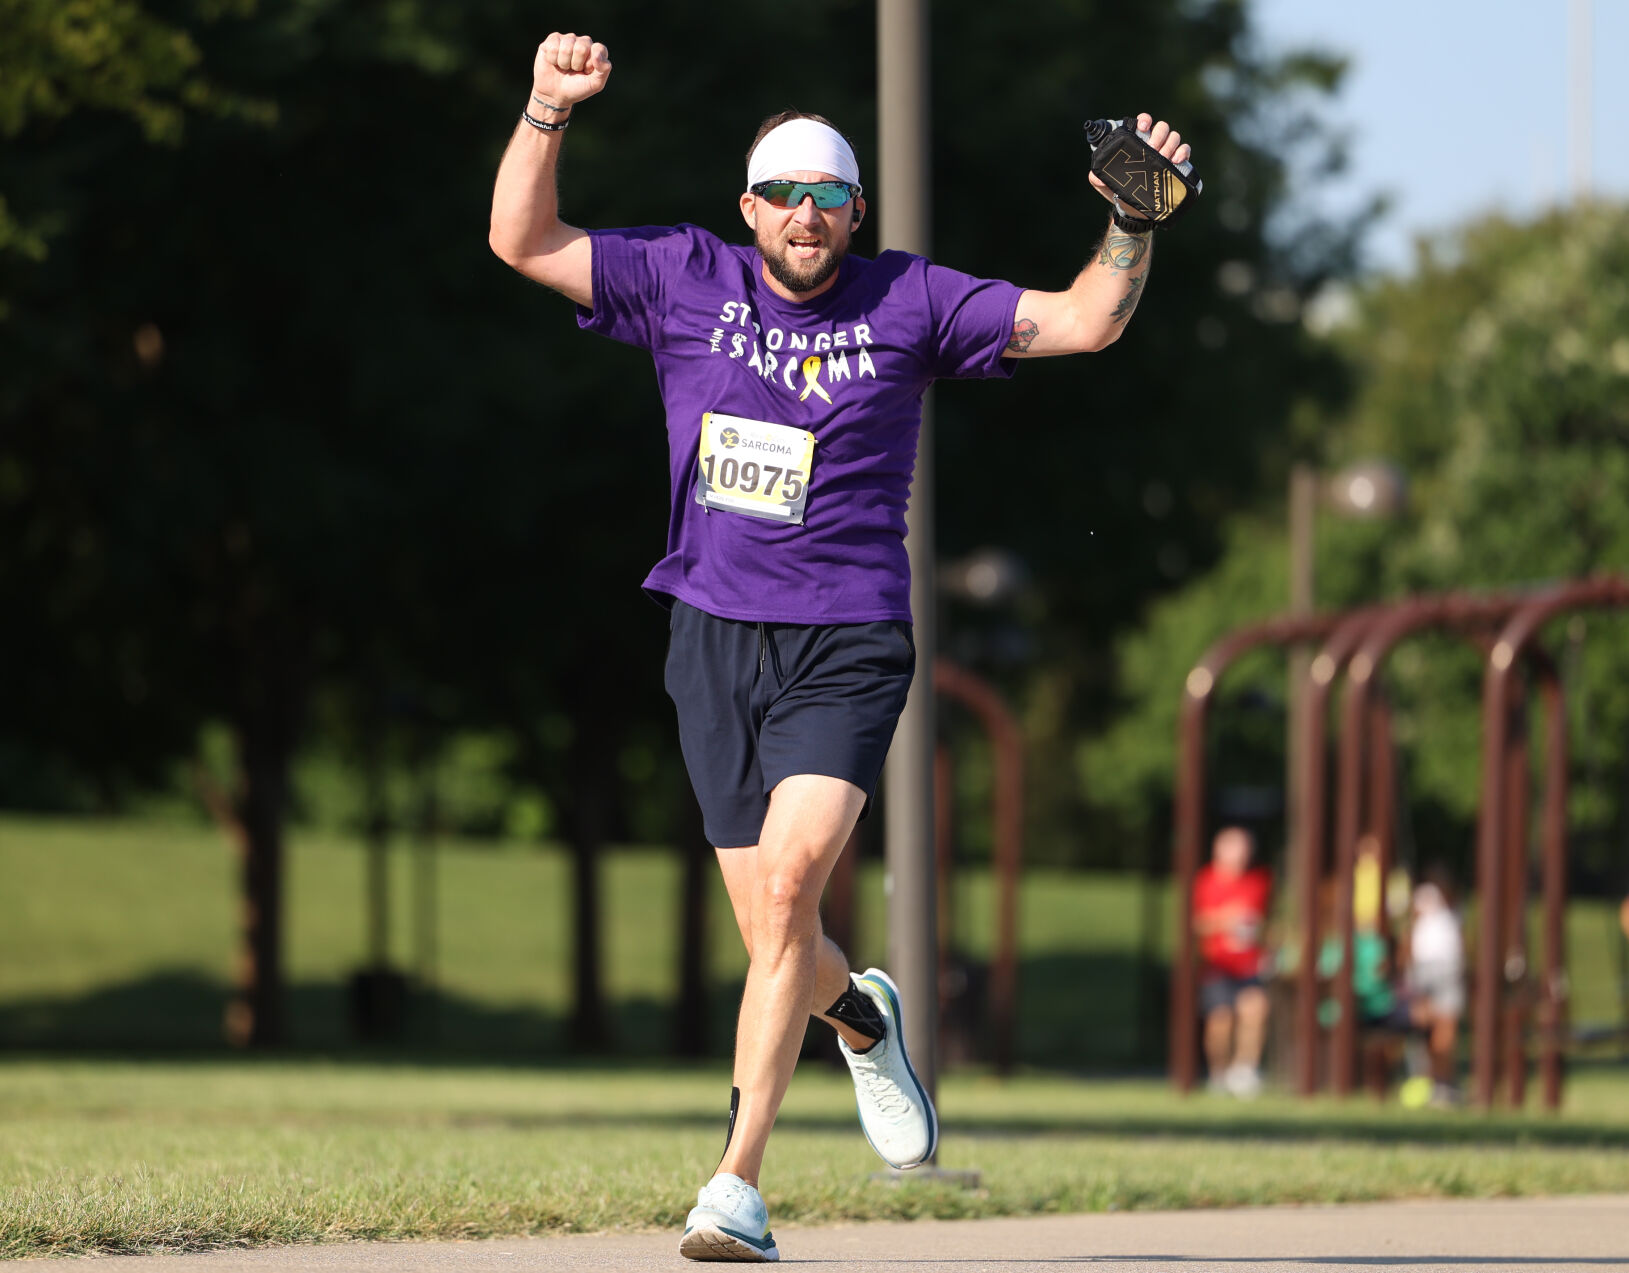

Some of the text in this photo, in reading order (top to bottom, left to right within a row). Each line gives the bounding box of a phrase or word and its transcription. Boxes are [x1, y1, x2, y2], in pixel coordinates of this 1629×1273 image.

[1153, 171, 1161, 212] NATHAN
[741, 438, 792, 456] SARCOMA
[704, 454, 804, 501] 10975
